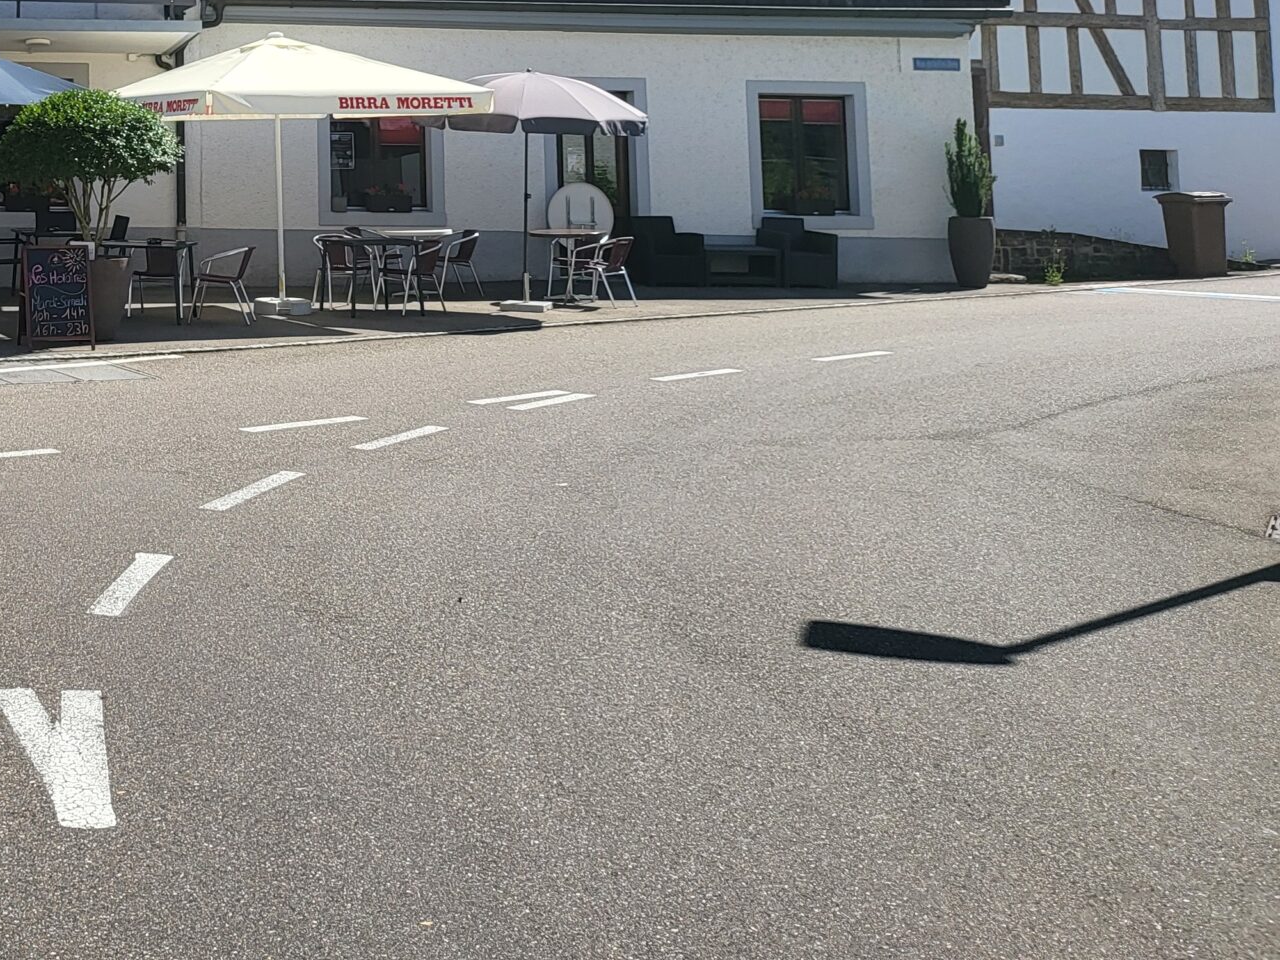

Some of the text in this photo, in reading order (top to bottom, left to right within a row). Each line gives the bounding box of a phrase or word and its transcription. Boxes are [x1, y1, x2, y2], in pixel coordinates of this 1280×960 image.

[338, 96, 473, 109] BIRRA MORETTI
[61, 307, 86, 320] 14h
[66, 321, 89, 337] 23h
